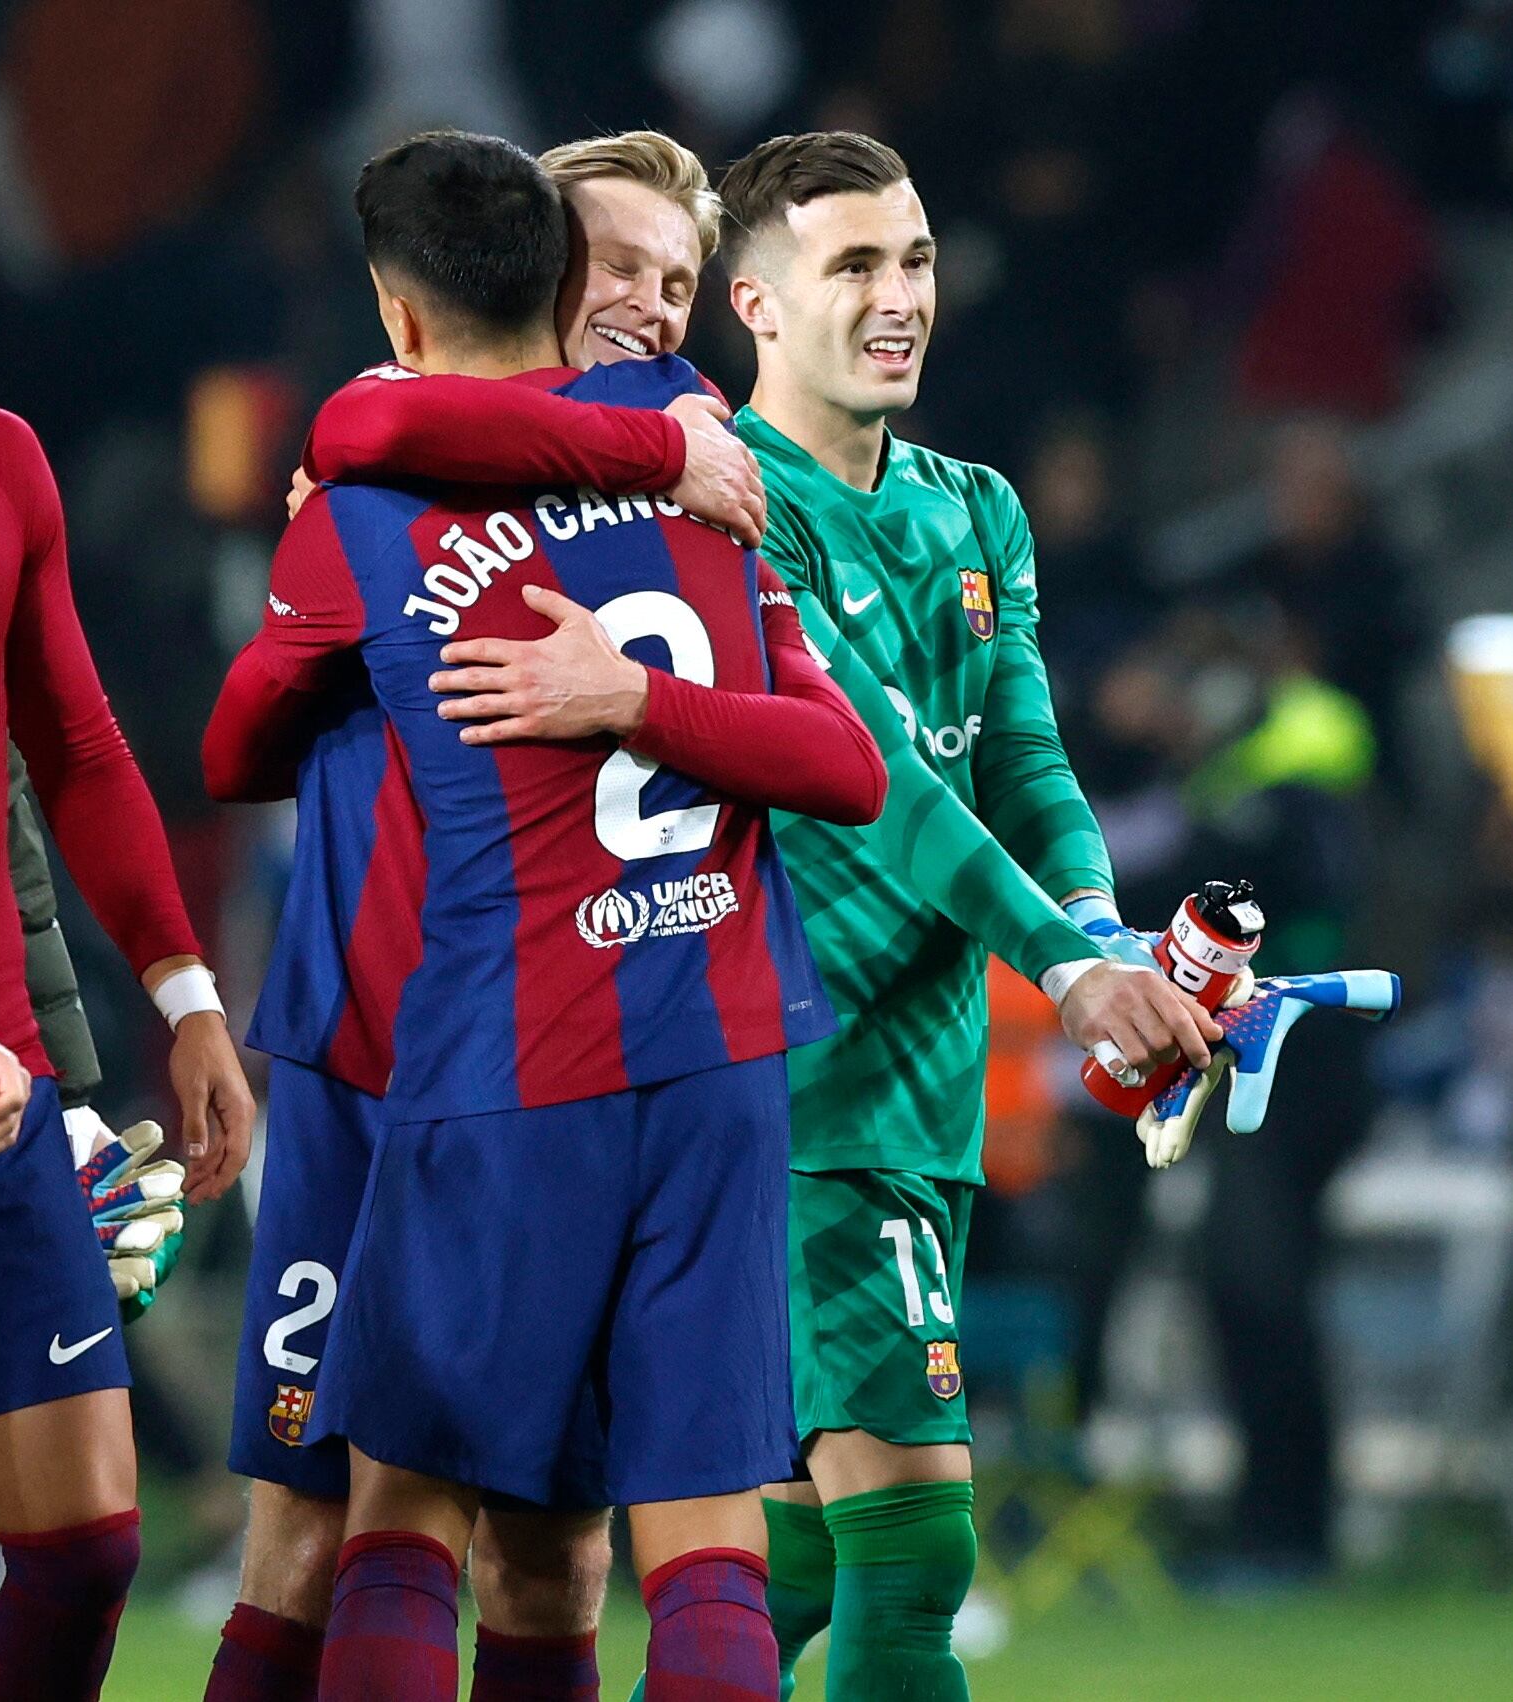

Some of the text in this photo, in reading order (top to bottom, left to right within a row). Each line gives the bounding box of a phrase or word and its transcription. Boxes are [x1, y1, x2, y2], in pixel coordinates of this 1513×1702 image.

[403, 511, 534, 635] JOÃO
[594, 590, 721, 861] 2
[650, 891, 737, 928] ACNUR
[263, 1260, 337, 1375] 2
[879, 1217, 954, 1327] 13
